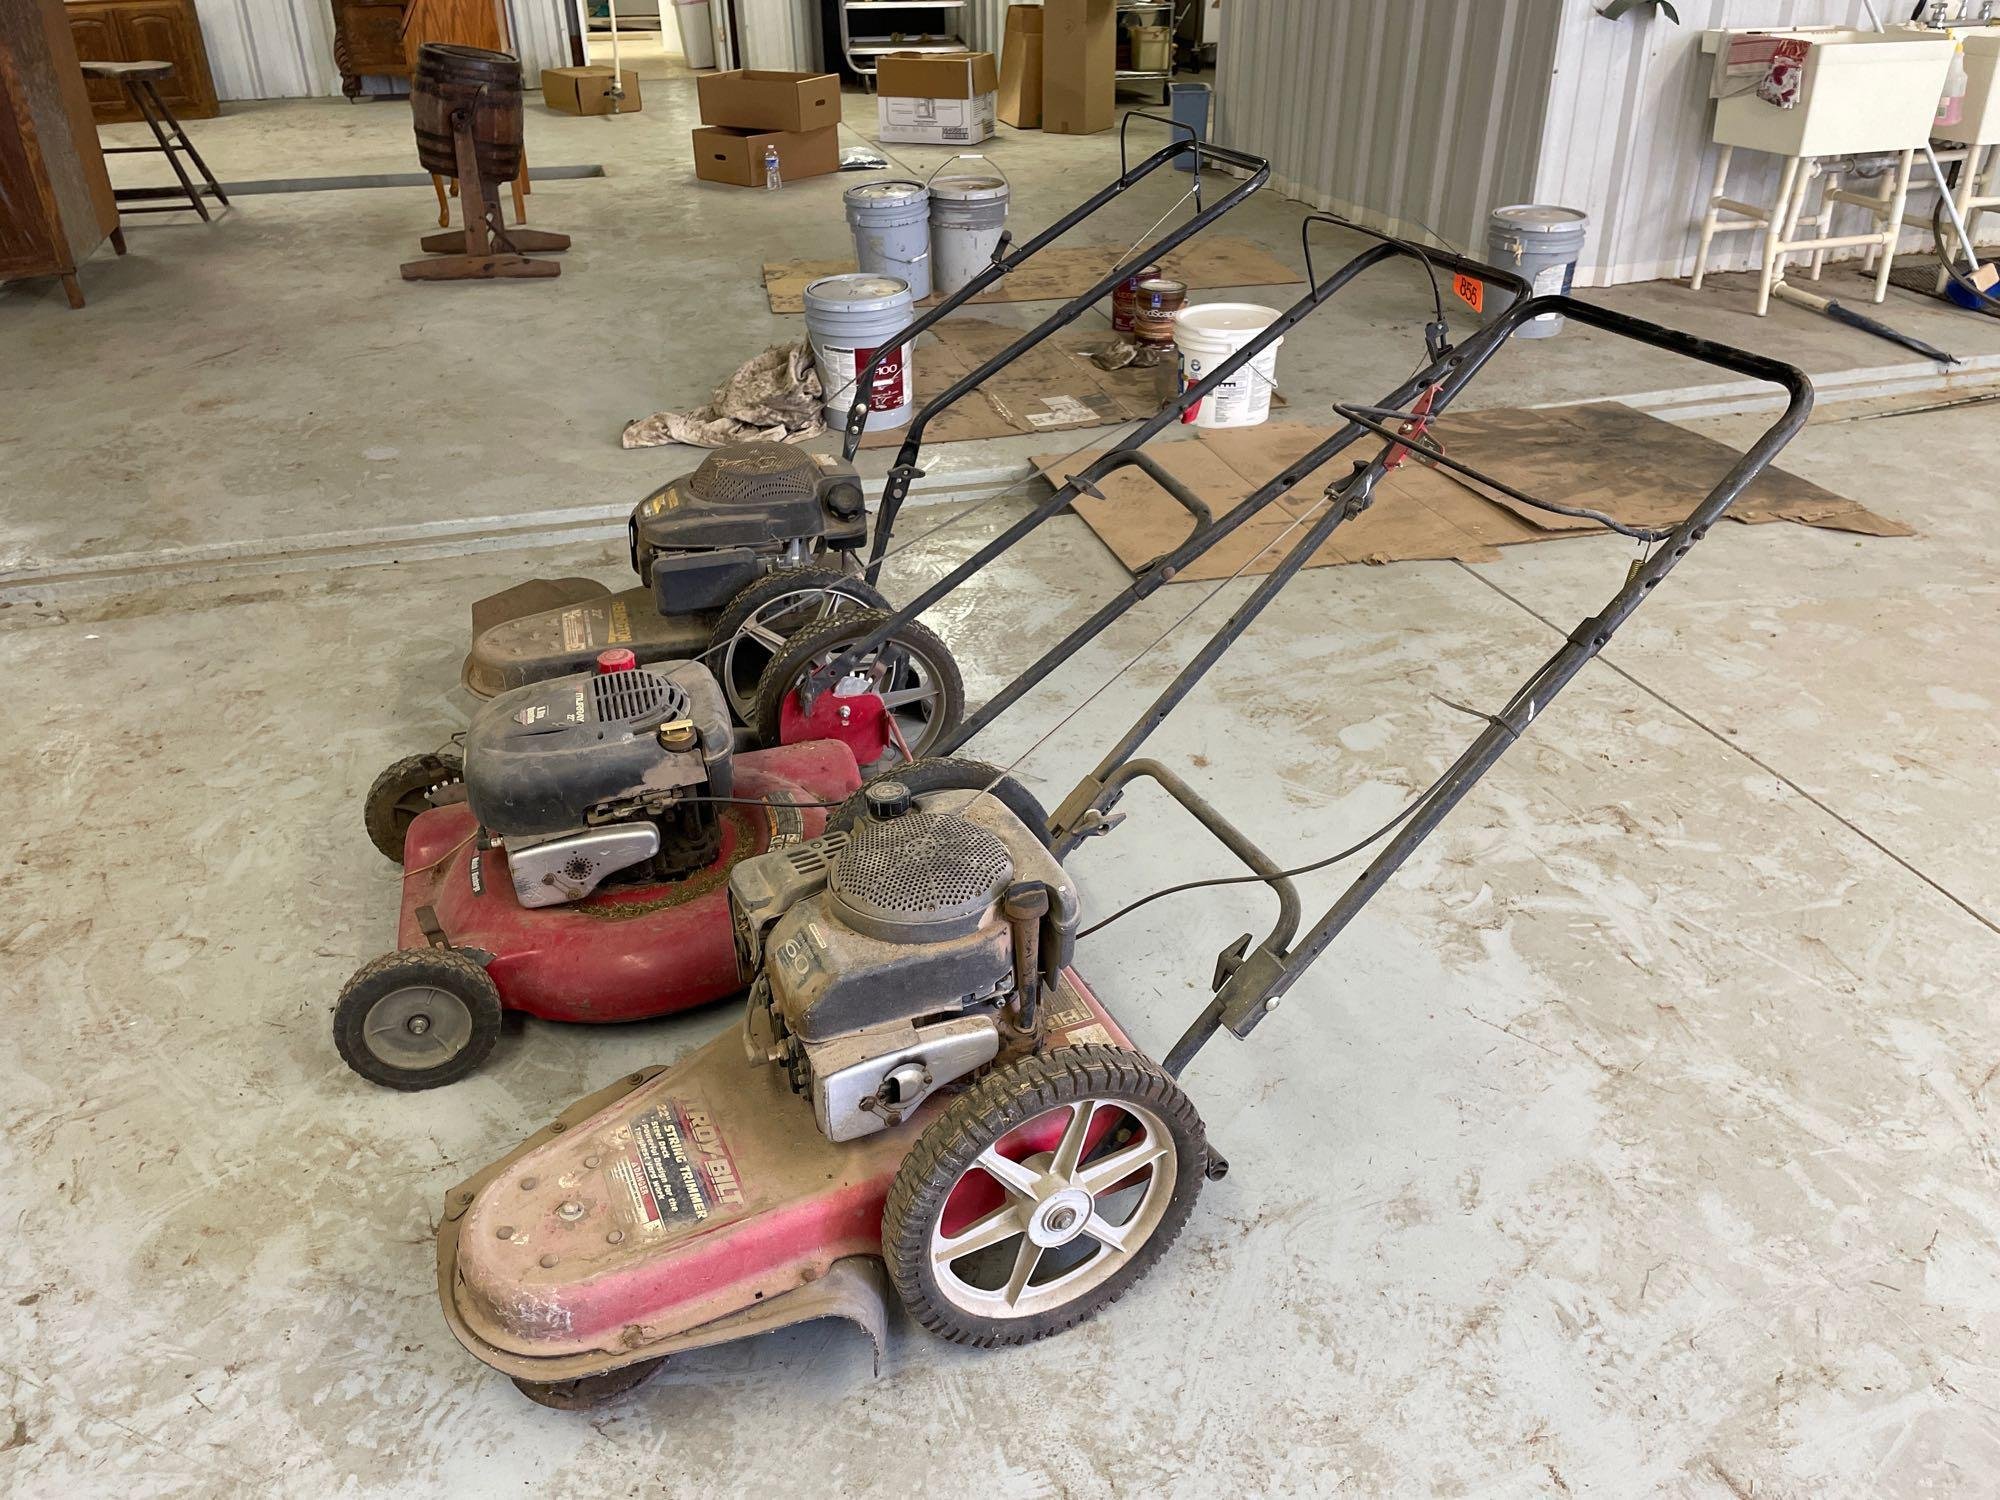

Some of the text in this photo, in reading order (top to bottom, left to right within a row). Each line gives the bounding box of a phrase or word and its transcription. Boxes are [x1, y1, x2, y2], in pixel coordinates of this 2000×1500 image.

[575, 692, 585, 722] MURRAY
[651, 1120, 670, 1159] Steel Deck
[633, 1166, 649, 1197] DANGER
[641, 1123, 679, 1213] Powerful Design for the
[645, 1159, 657, 1180] yard
[651, 1180, 665, 1201] work
[664, 1124, 688, 1164] STRING
[680, 1165, 708, 1219] TRIMMER
